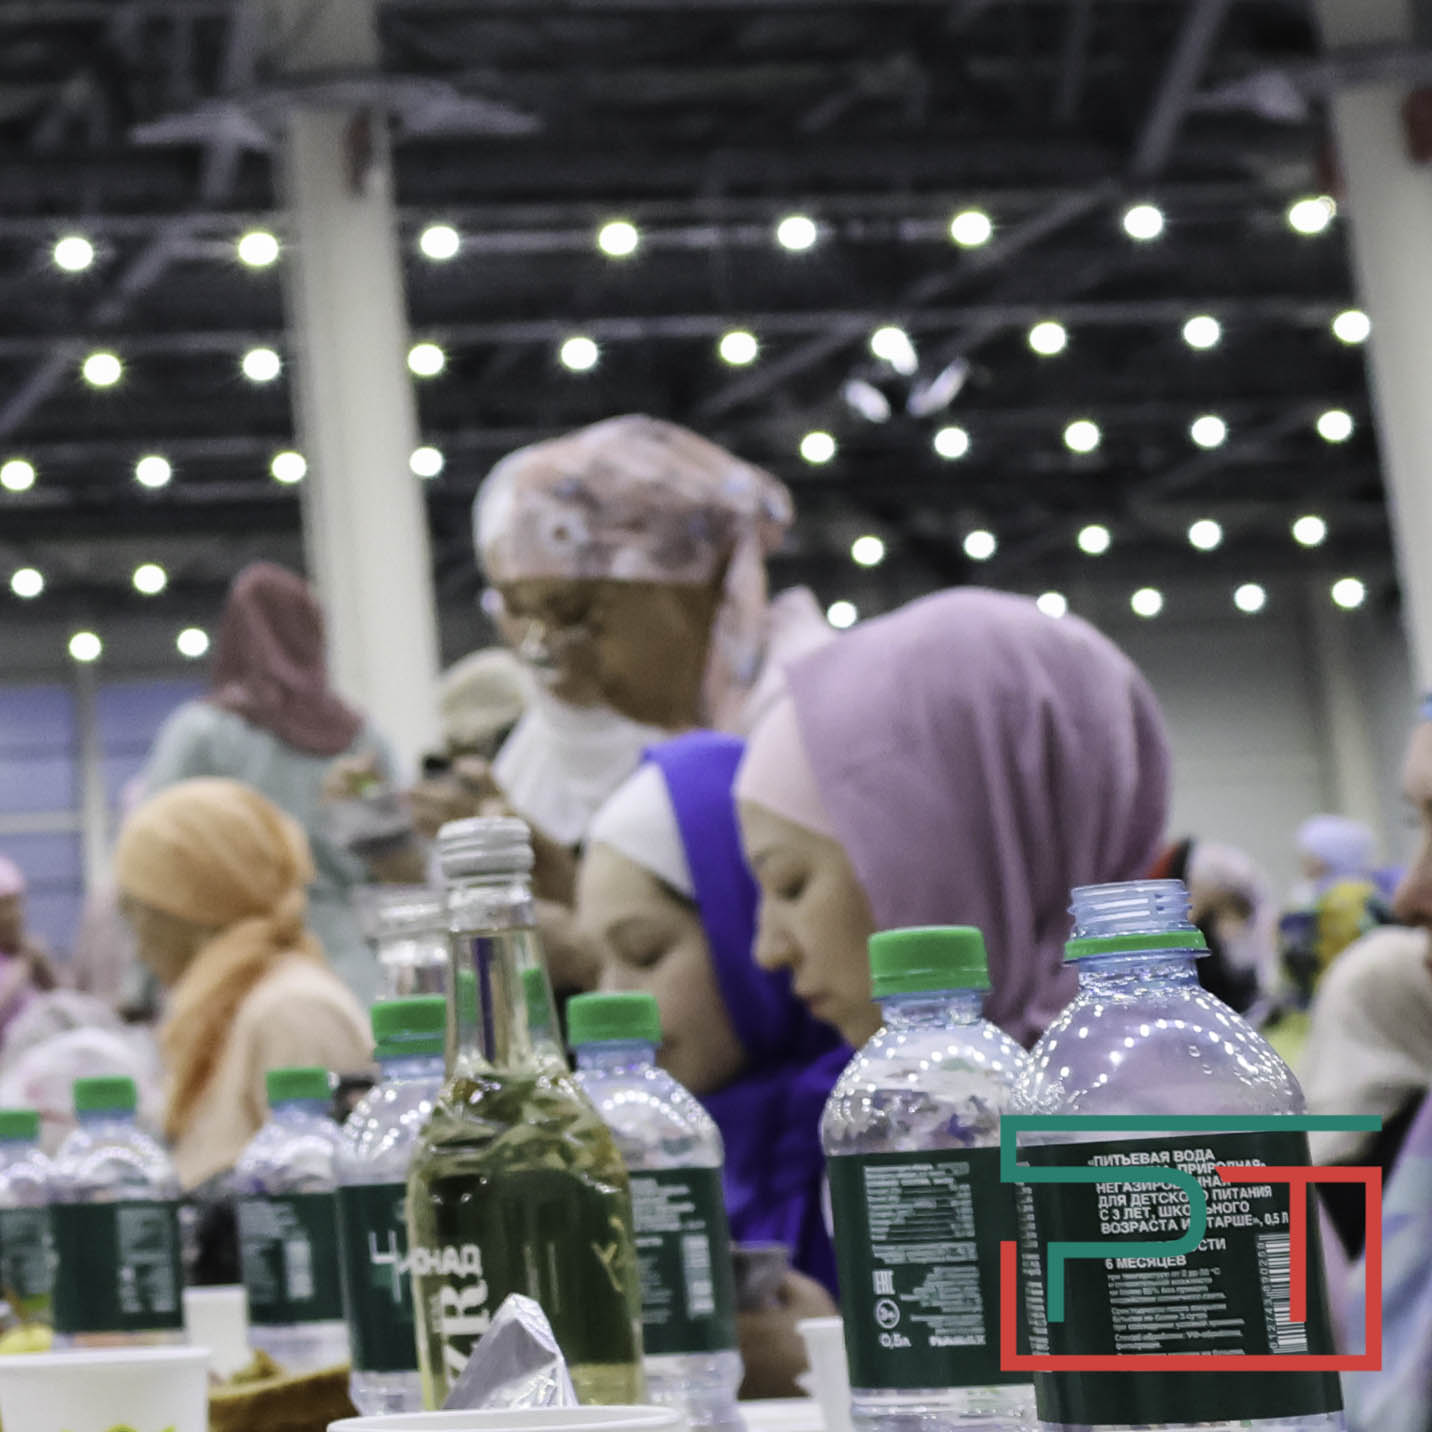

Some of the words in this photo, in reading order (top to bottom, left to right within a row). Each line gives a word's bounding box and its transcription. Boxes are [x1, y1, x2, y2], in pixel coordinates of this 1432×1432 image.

[1173, 1149, 1215, 1163] ВОДА
[1098, 1194, 1127, 1208] ДЛЯ
[1130, 1190, 1209, 1207] ДЕТСКОО
[1212, 1186, 1272, 1200] ПИТАНИЯ
[1099, 1209, 1109, 1221] С
[1112, 1209, 1120, 1220] 3
[1123, 1207, 1156, 1221] ЛЕТ,
[1101, 1219, 1178, 1234] ВОЗРАСТА
[1105, 1258, 1114, 1270] 6
[1117, 1255, 1187, 1268] МЕСЯЦЕВ
